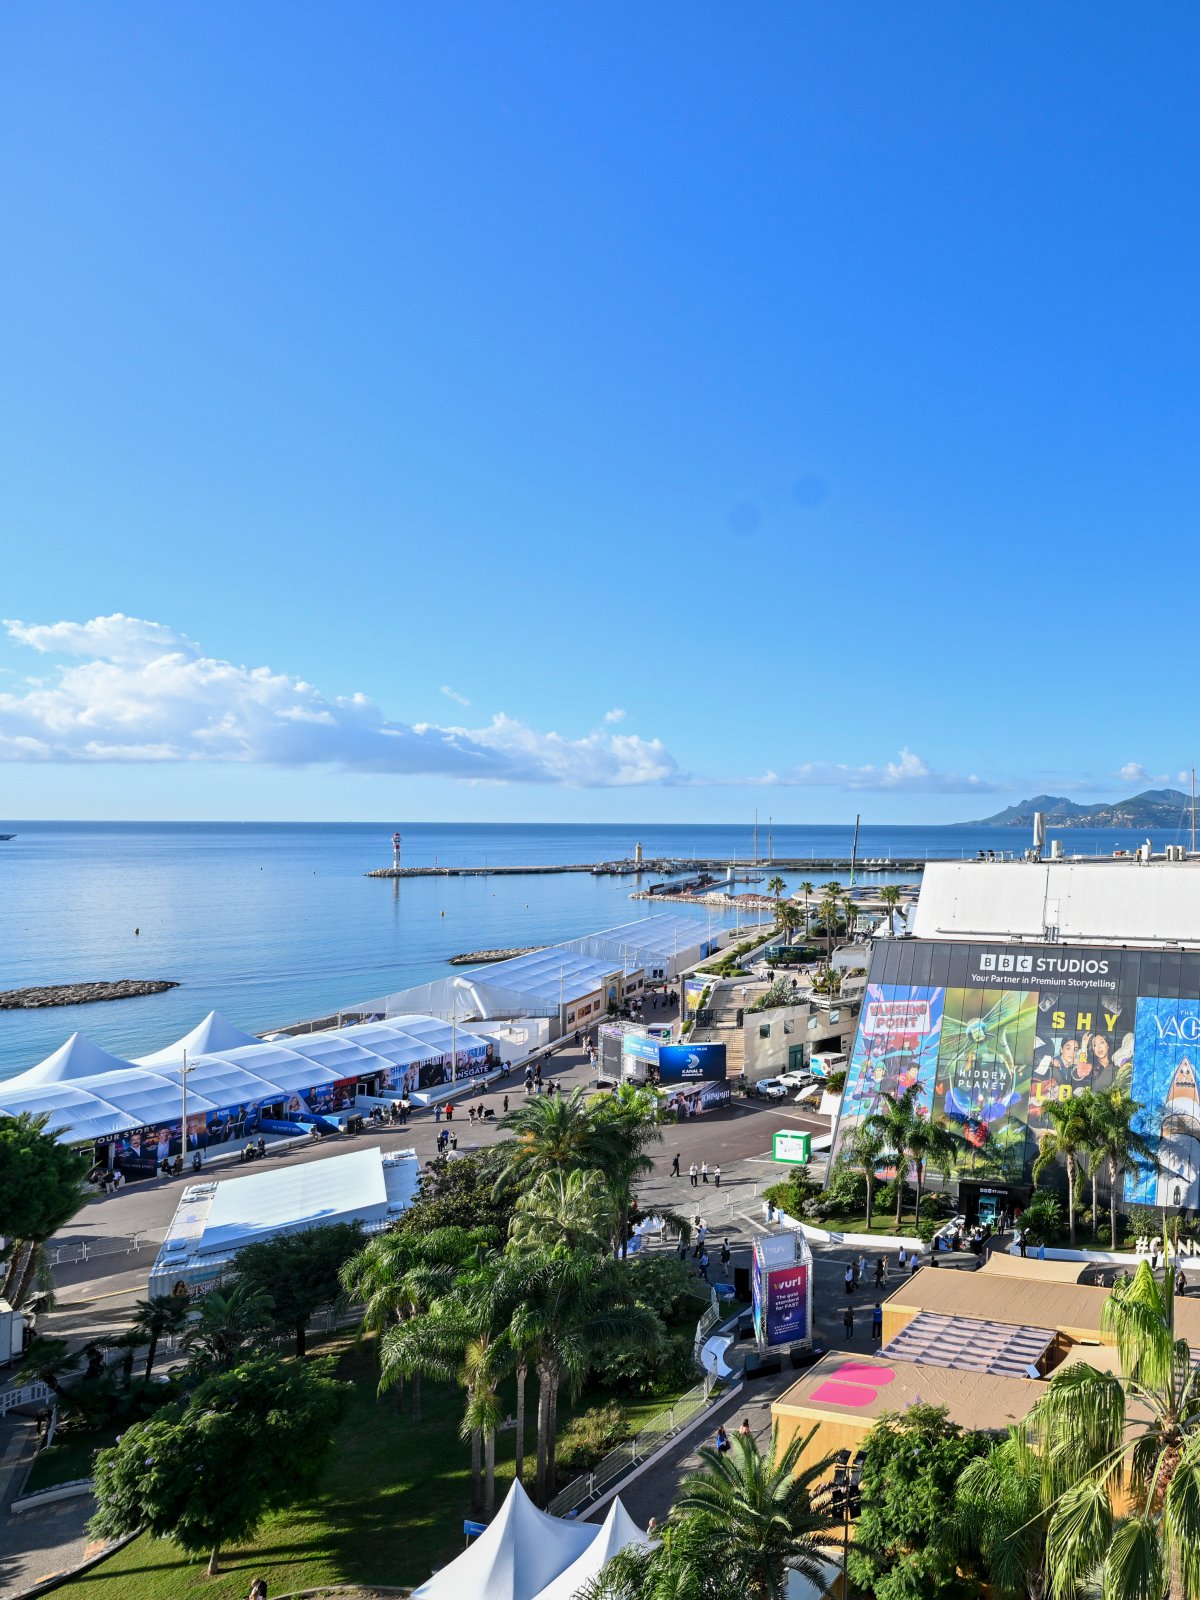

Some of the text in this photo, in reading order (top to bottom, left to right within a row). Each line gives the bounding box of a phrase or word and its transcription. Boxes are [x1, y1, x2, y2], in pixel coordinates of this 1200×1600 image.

[981, 954, 1109, 974] BBC STUDIOS
[972, 974, 1116, 990] Your Partner in Premium Storytelling
[869, 1003, 928, 1017] VANISHING
[876, 1016, 918, 1029] POINT
[1052, 1011, 1120, 1032] SHY
[959, 1069, 1006, 1080] HIDDEN
[958, 1079, 1006, 1090] PLANET
[216, 1109, 230, 1117] FOX
[124, 1125, 157, 1138] STORY
[774, 1277, 801, 1290] wurl
[776, 1297, 799, 1306] standard
[787, 1291, 799, 1299] gold
